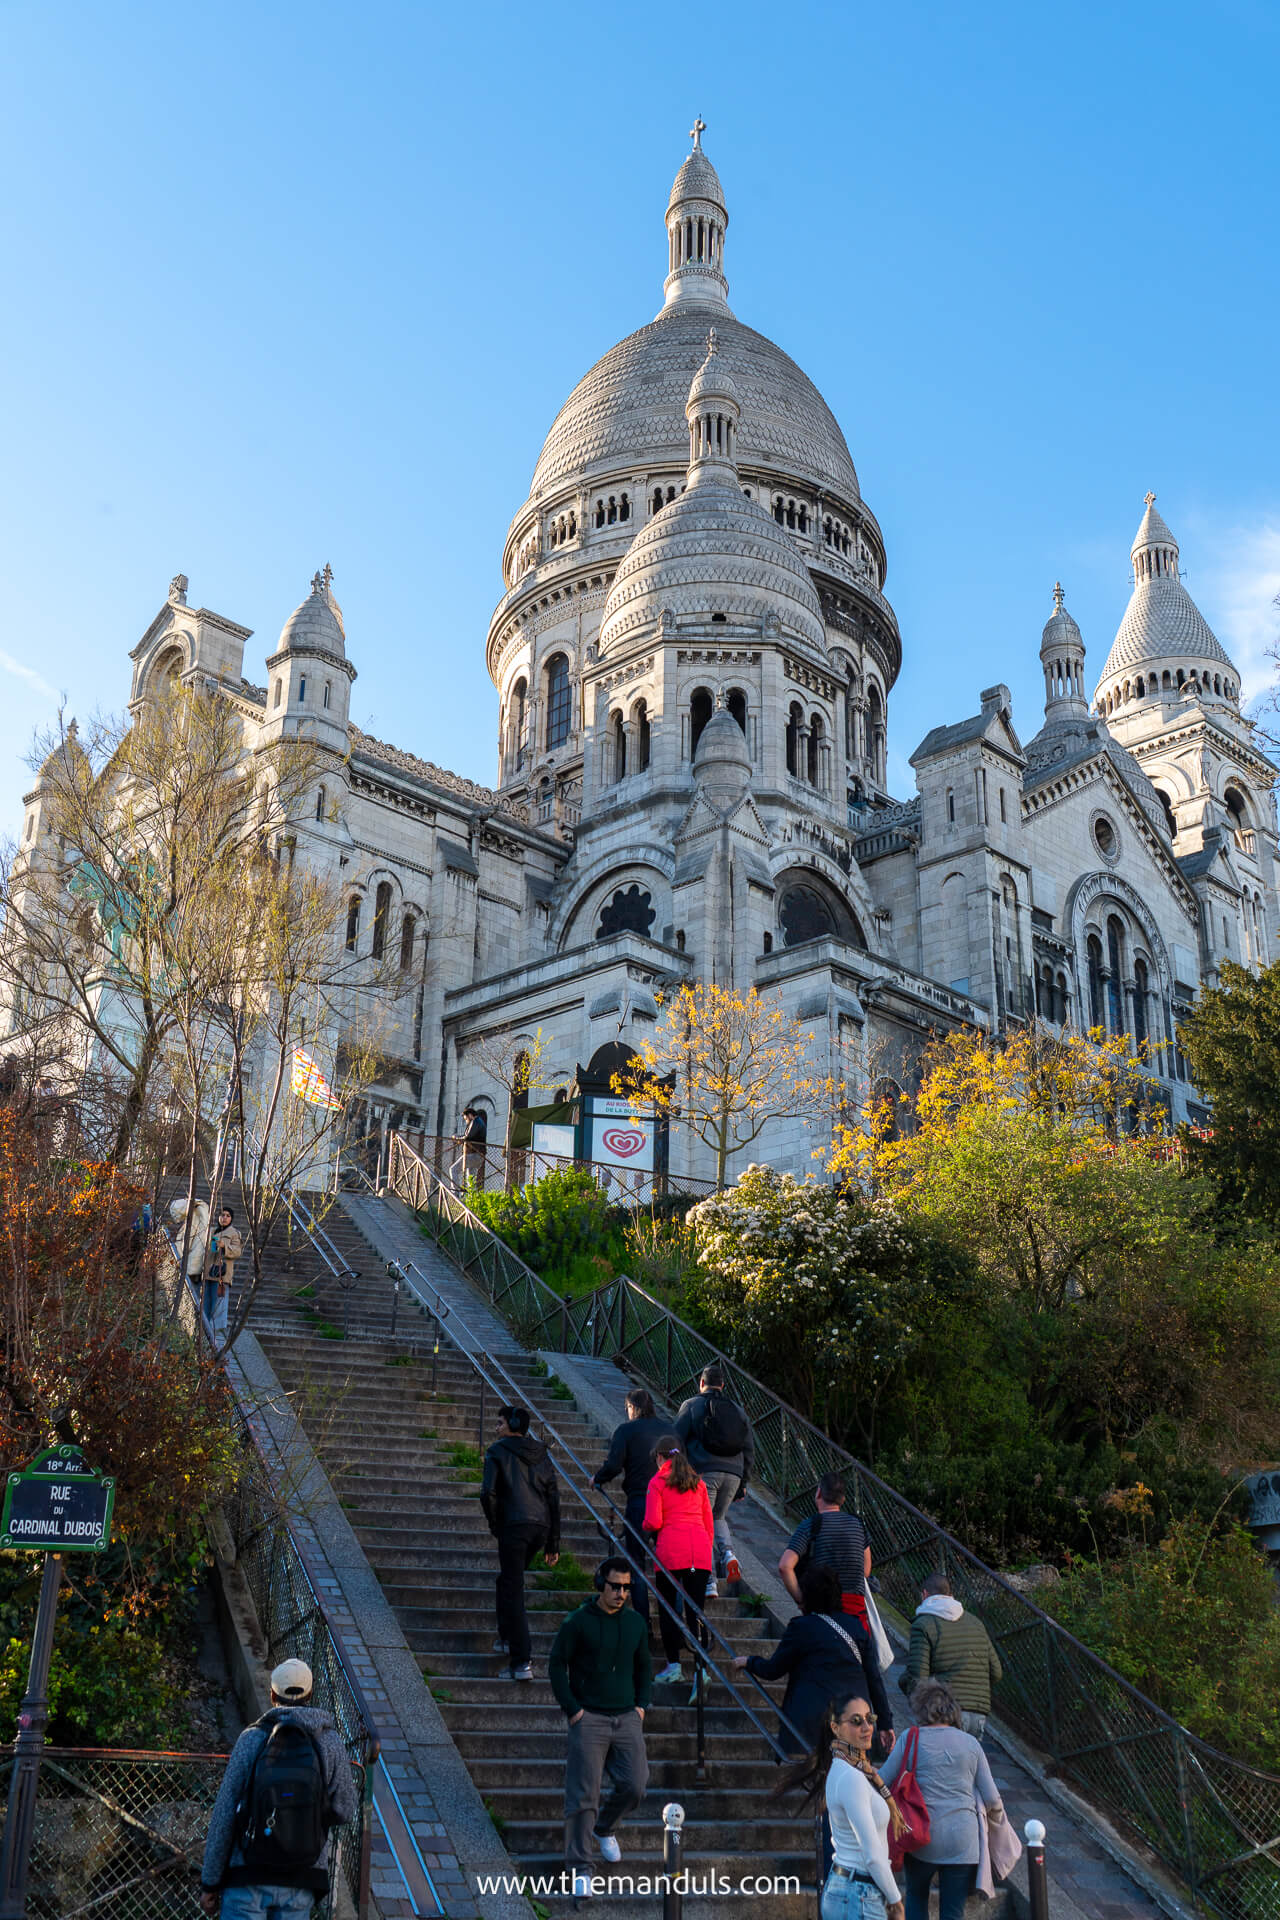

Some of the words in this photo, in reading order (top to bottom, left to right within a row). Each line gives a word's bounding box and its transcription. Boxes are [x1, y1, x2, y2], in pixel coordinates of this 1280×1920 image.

[50, 1485, 71, 1501] RUE
[53, 1506, 64, 1515] DU
[9, 1519, 61, 1535] CARDINAL
[64, 1521, 103, 1537] DUBOIS
